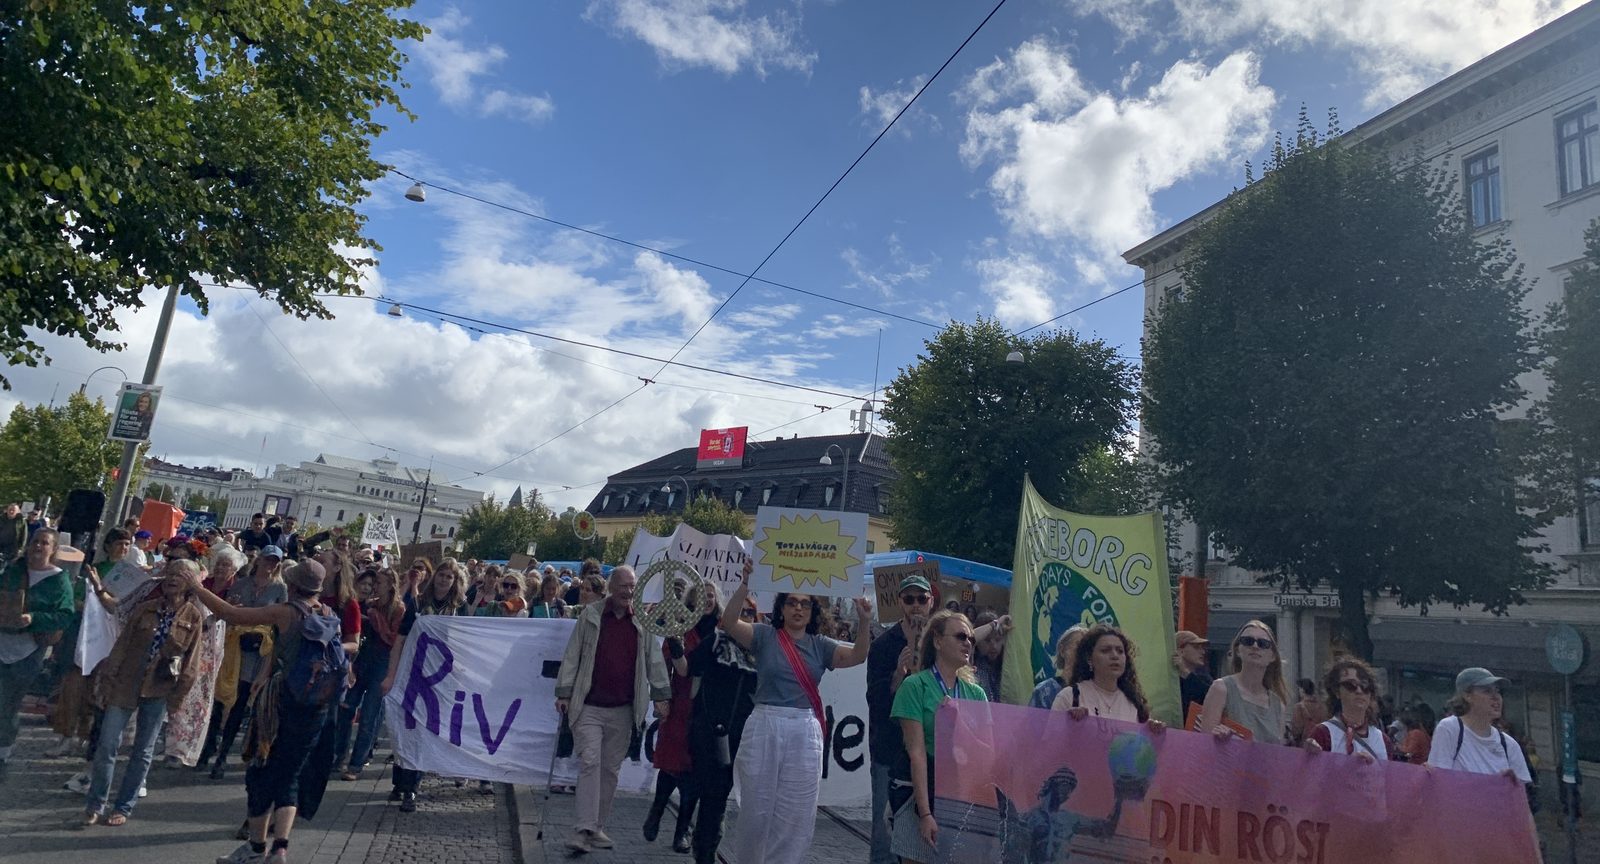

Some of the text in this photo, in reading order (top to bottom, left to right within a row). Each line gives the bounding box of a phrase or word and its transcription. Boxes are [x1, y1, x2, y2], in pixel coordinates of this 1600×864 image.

[775, 541, 837, 551] TOTALVÄGRA
[878, 573, 897, 590] OM
[1272, 593, 1342, 607] Danske Ban
[1150, 799, 1331, 864] DIN RÖST
